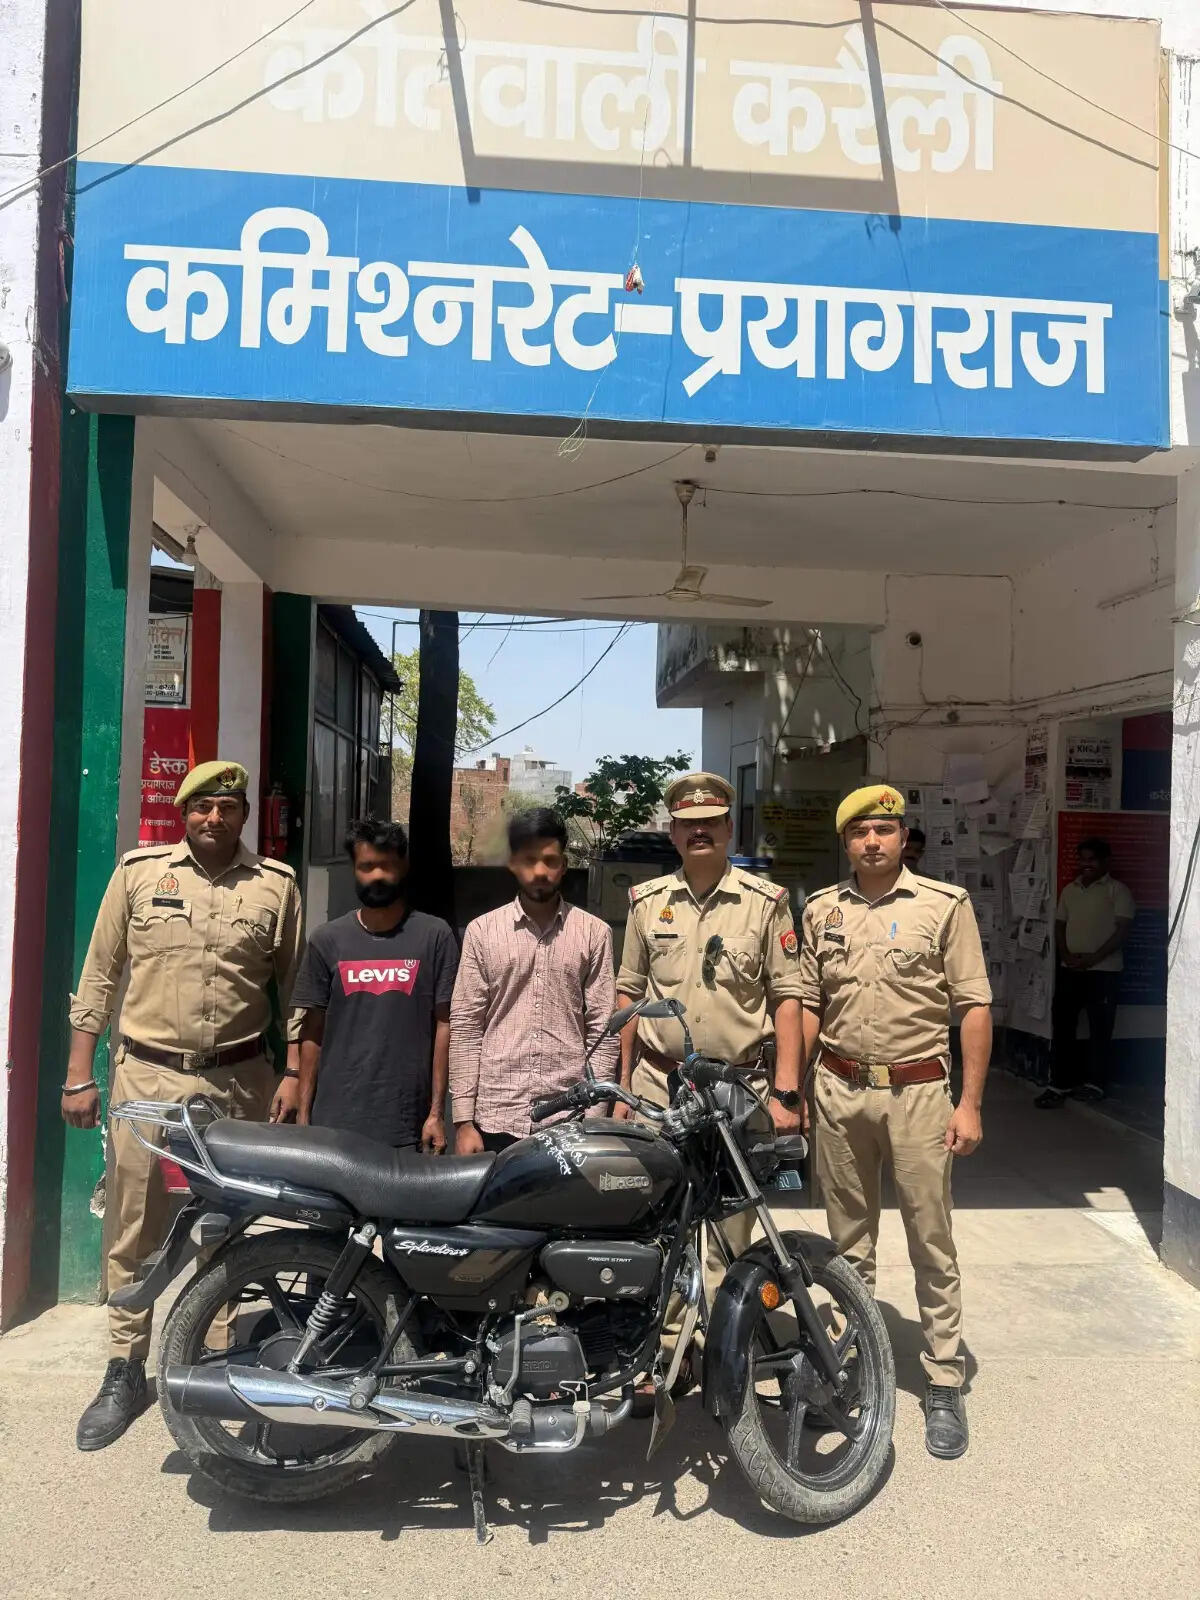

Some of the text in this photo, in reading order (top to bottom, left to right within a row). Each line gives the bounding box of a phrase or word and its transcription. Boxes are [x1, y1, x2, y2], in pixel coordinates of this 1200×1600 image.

[263, 0, 1003, 173] कोतवाली करैली
[149, 750, 189, 775] डेस्क
